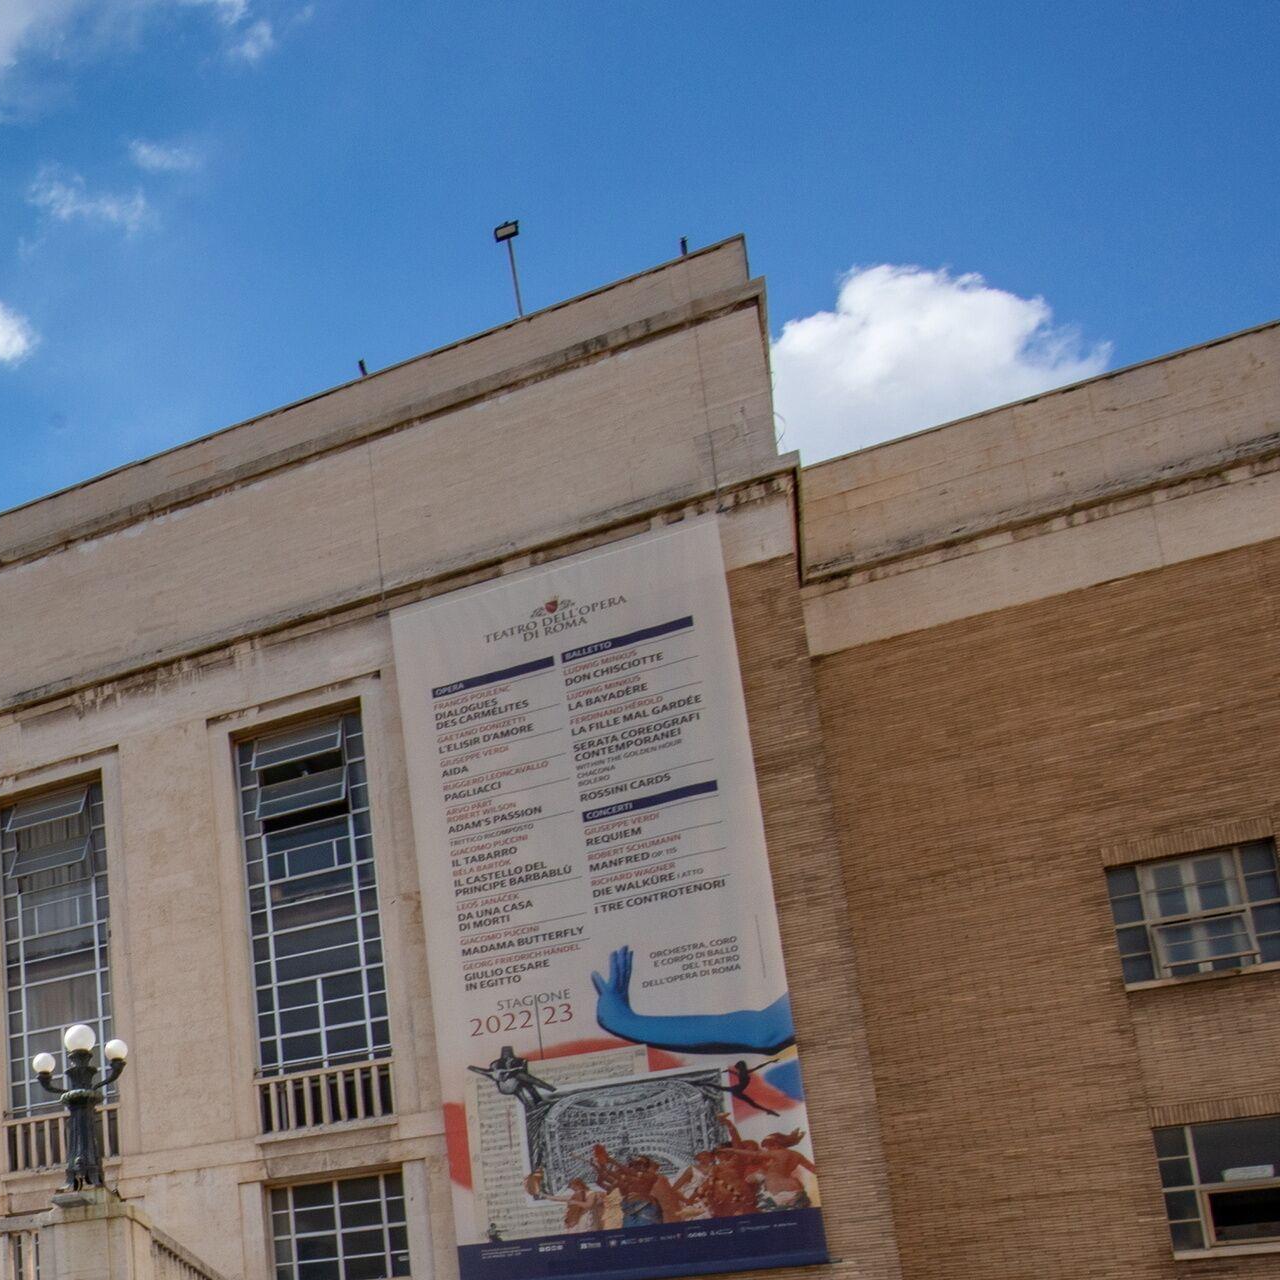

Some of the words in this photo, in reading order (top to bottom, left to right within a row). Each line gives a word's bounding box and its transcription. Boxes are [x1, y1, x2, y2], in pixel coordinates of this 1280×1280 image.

[484, 621, 537, 643] TEATRO
[542, 595, 627, 627] DELL'OPERA
[523, 629, 539, 642] DI
[545, 616, 588, 636] ROMA
[565, 641, 612, 660] BALLETTO
[563, 660, 599, 676] LUDWIG
[601, 650, 638, 665] MINKUS
[565, 674, 591, 687] DON
[593, 652, 664, 678] CHISCIOTTE
[434, 682, 465, 696] OPERA
[434, 697, 470, 711] FRANCIS
[470, 685, 511, 701] POULENC
[566, 686, 603, 701] LUDWIG
[604, 675, 641, 690] MINKUS
[435, 698, 498, 721] DIALOGUES
[568, 700, 583, 712] LA
[570, 706, 623, 725] FERDINAND
[571, 727, 587, 737] LA
[589, 717, 621, 732] FILLE
[622, 710, 649, 723] MAL
[651, 694, 702, 715] GARDÉE
[436, 717, 457, 730] DES
[437, 728, 478, 743] GAETANO
[479, 716, 526, 733] DONIZETTI
[573, 734, 618, 752] SERATA
[621, 712, 701, 739] COREOGRAFI
[439, 737, 480, 754] L'ELISIR
[483, 723, 534, 743] D'AMORE
[574, 727, 682, 762] CONTEMPORANEI
[440, 752, 481, 768] GIUSEPPE
[483, 745, 509, 757] VERDI
[576, 760, 605, 771] WITHIN
[607, 755, 621, 763] THE
[623, 746, 657, 759] GOLDEN
[658, 738, 682, 749] HOUR
[442, 765, 469, 778] AIDA
[443, 776, 485, 791] RUGGERO
[485, 760, 549, 781] LEONCAVALLO
[577, 765, 616, 779] CHACONA
[578, 774, 610, 787] BOLERO
[444, 781, 502, 802] PAGLIACCI
[580, 783, 628, 802] ROSSINI
[629, 773, 671, 790] CARDS
[446, 805, 470, 816] ARVO
[447, 810, 480, 823] ROBERT
[482, 802, 517, 816] WILSON
[448, 817, 491, 834] ADAM'S
[493, 806, 542, 824] PASSION
[585, 803, 633, 820] CONCERTI
[484, 823, 534, 840] RICOMPOSTO
[584, 820, 628, 836] GIUSEPPE
[630, 812, 660, 825] VERDI
[450, 842, 492, 857] GIACOMO
[493, 834, 528, 848] PUCCINI
[586, 826, 642, 847] REQUIEM
[588, 847, 625, 861] ROBERT
[626, 833, 681, 853] SCHUMANN
[452, 859, 461, 867] IL
[464, 846, 518, 865] TABARRO
[589, 851, 650, 872] MANFRED
[454, 878, 464, 888] IL
[466, 865, 523, 885] CASTELLO
[525, 861, 547, 872] DEL
[591, 871, 633, 887] RICHARD
[634, 862, 676, 877] WAGNER
[593, 886, 613, 898] DIE
[681, 867, 704, 878] ATTO
[455, 881, 507, 897] PRINCIPE
[601, 901, 625, 913] TRE
[626, 879, 726, 908] CONTROTENORI
[457, 911, 474, 922] DA
[476, 907, 501, 918] UNA
[503, 900, 533, 913] CASA
[459, 922, 471, 932] DI
[473, 915, 510, 929] MORTI
[460, 932, 502, 946] GIACOMO
[503, 926, 540, 937] PUCCINI
[461, 940, 515, 957] MADAMA
[517, 926, 585, 946] BUTTERFLY
[709, 936, 738, 947] CORO
[463, 960, 494, 971] GEORG
[495, 951, 541, 966] FRIEDRICH
[653, 959, 660, 968] E
[660, 953, 694, 966] CORPO
[696, 951, 706, 959] DI
[707, 945, 739, 957] BALLO
[682, 961, 700, 971] DEL
[703, 954, 740, 967] TEATRO
[464, 966, 504, 982] GIULIO
[505, 959, 550, 974] CESARE
[642, 972, 699, 988] DELL'OPERA
[700, 968, 710, 977] DI
[711, 963, 742, 975] ROMA
[465, 981, 477, 991] IN
[480, 974, 522, 989] EGITTO
[470, 1009, 534, 1037] 2022
[543, 1003, 574, 1025] 23
